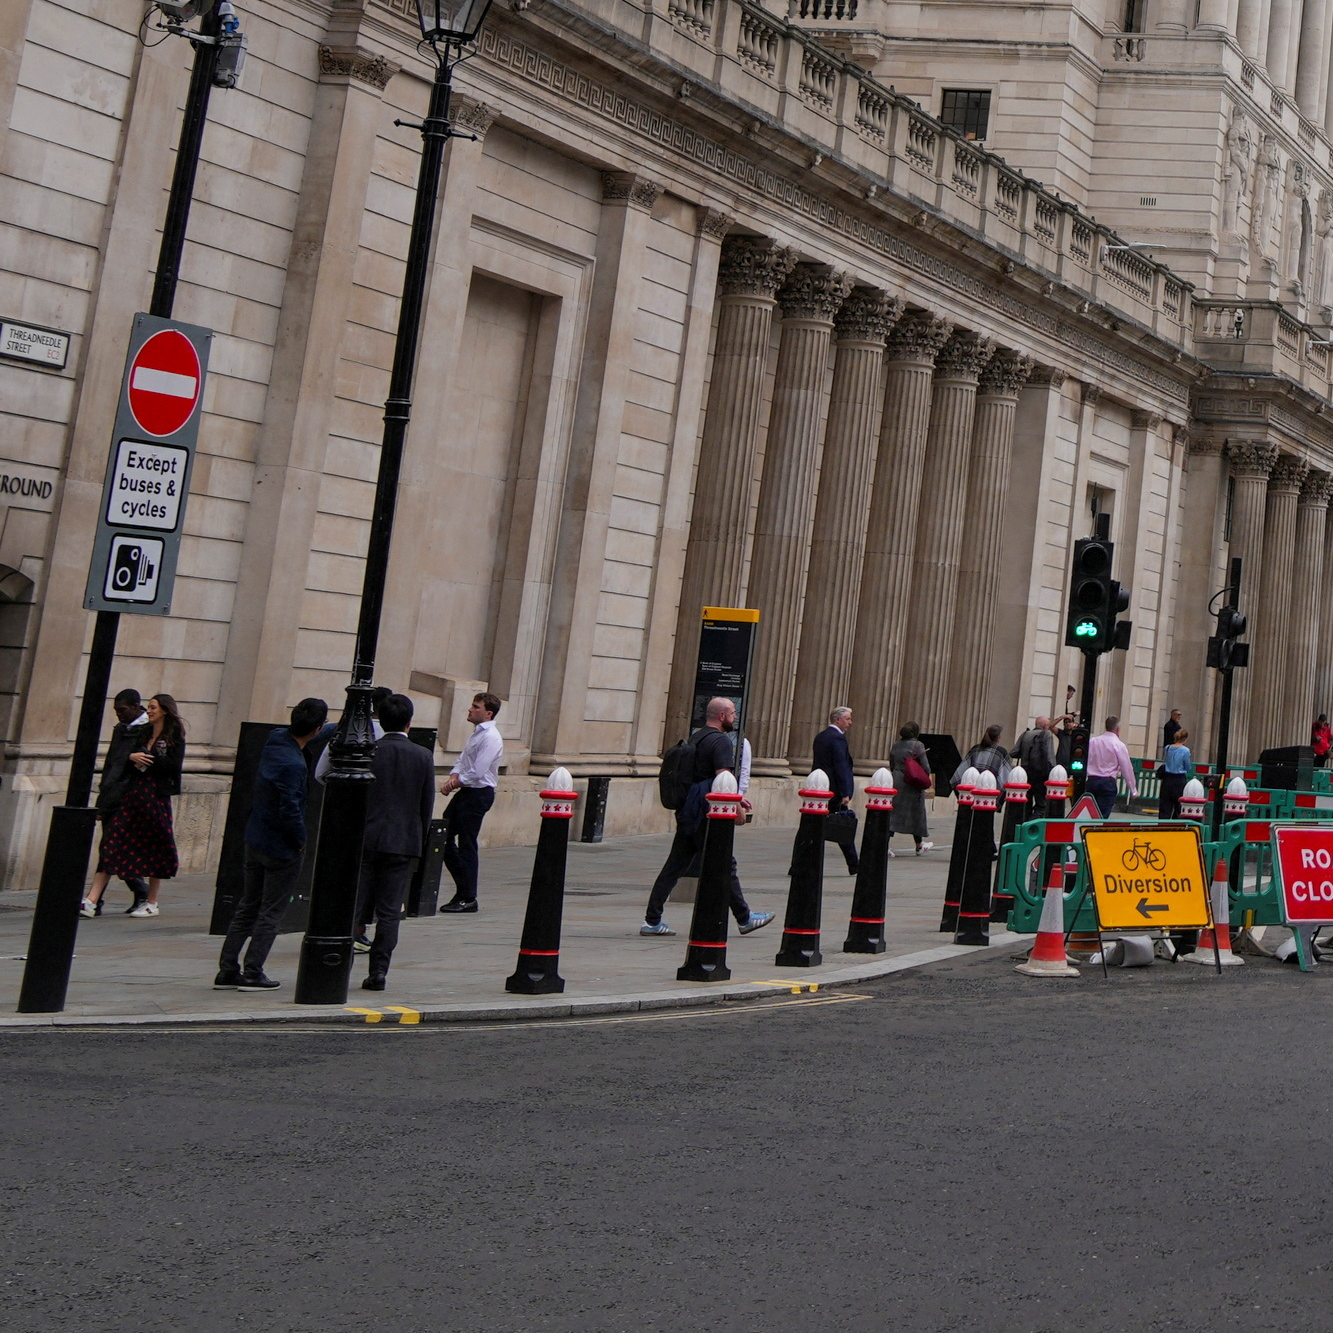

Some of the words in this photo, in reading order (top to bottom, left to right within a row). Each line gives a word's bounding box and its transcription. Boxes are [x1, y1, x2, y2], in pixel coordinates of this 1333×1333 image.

[10, 328, 62, 348] THREADNEEDLE
[7, 340, 31, 354] STREET
[46, 348, 60, 361] EC2
[127, 450, 177, 475] Except
[0, 474, 53, 499] ROUND
[119, 473, 162, 495] buses
[167, 479, 176, 497] &
[121, 500, 167, 519] cycles
[1103, 873, 1192, 895] Diversion
